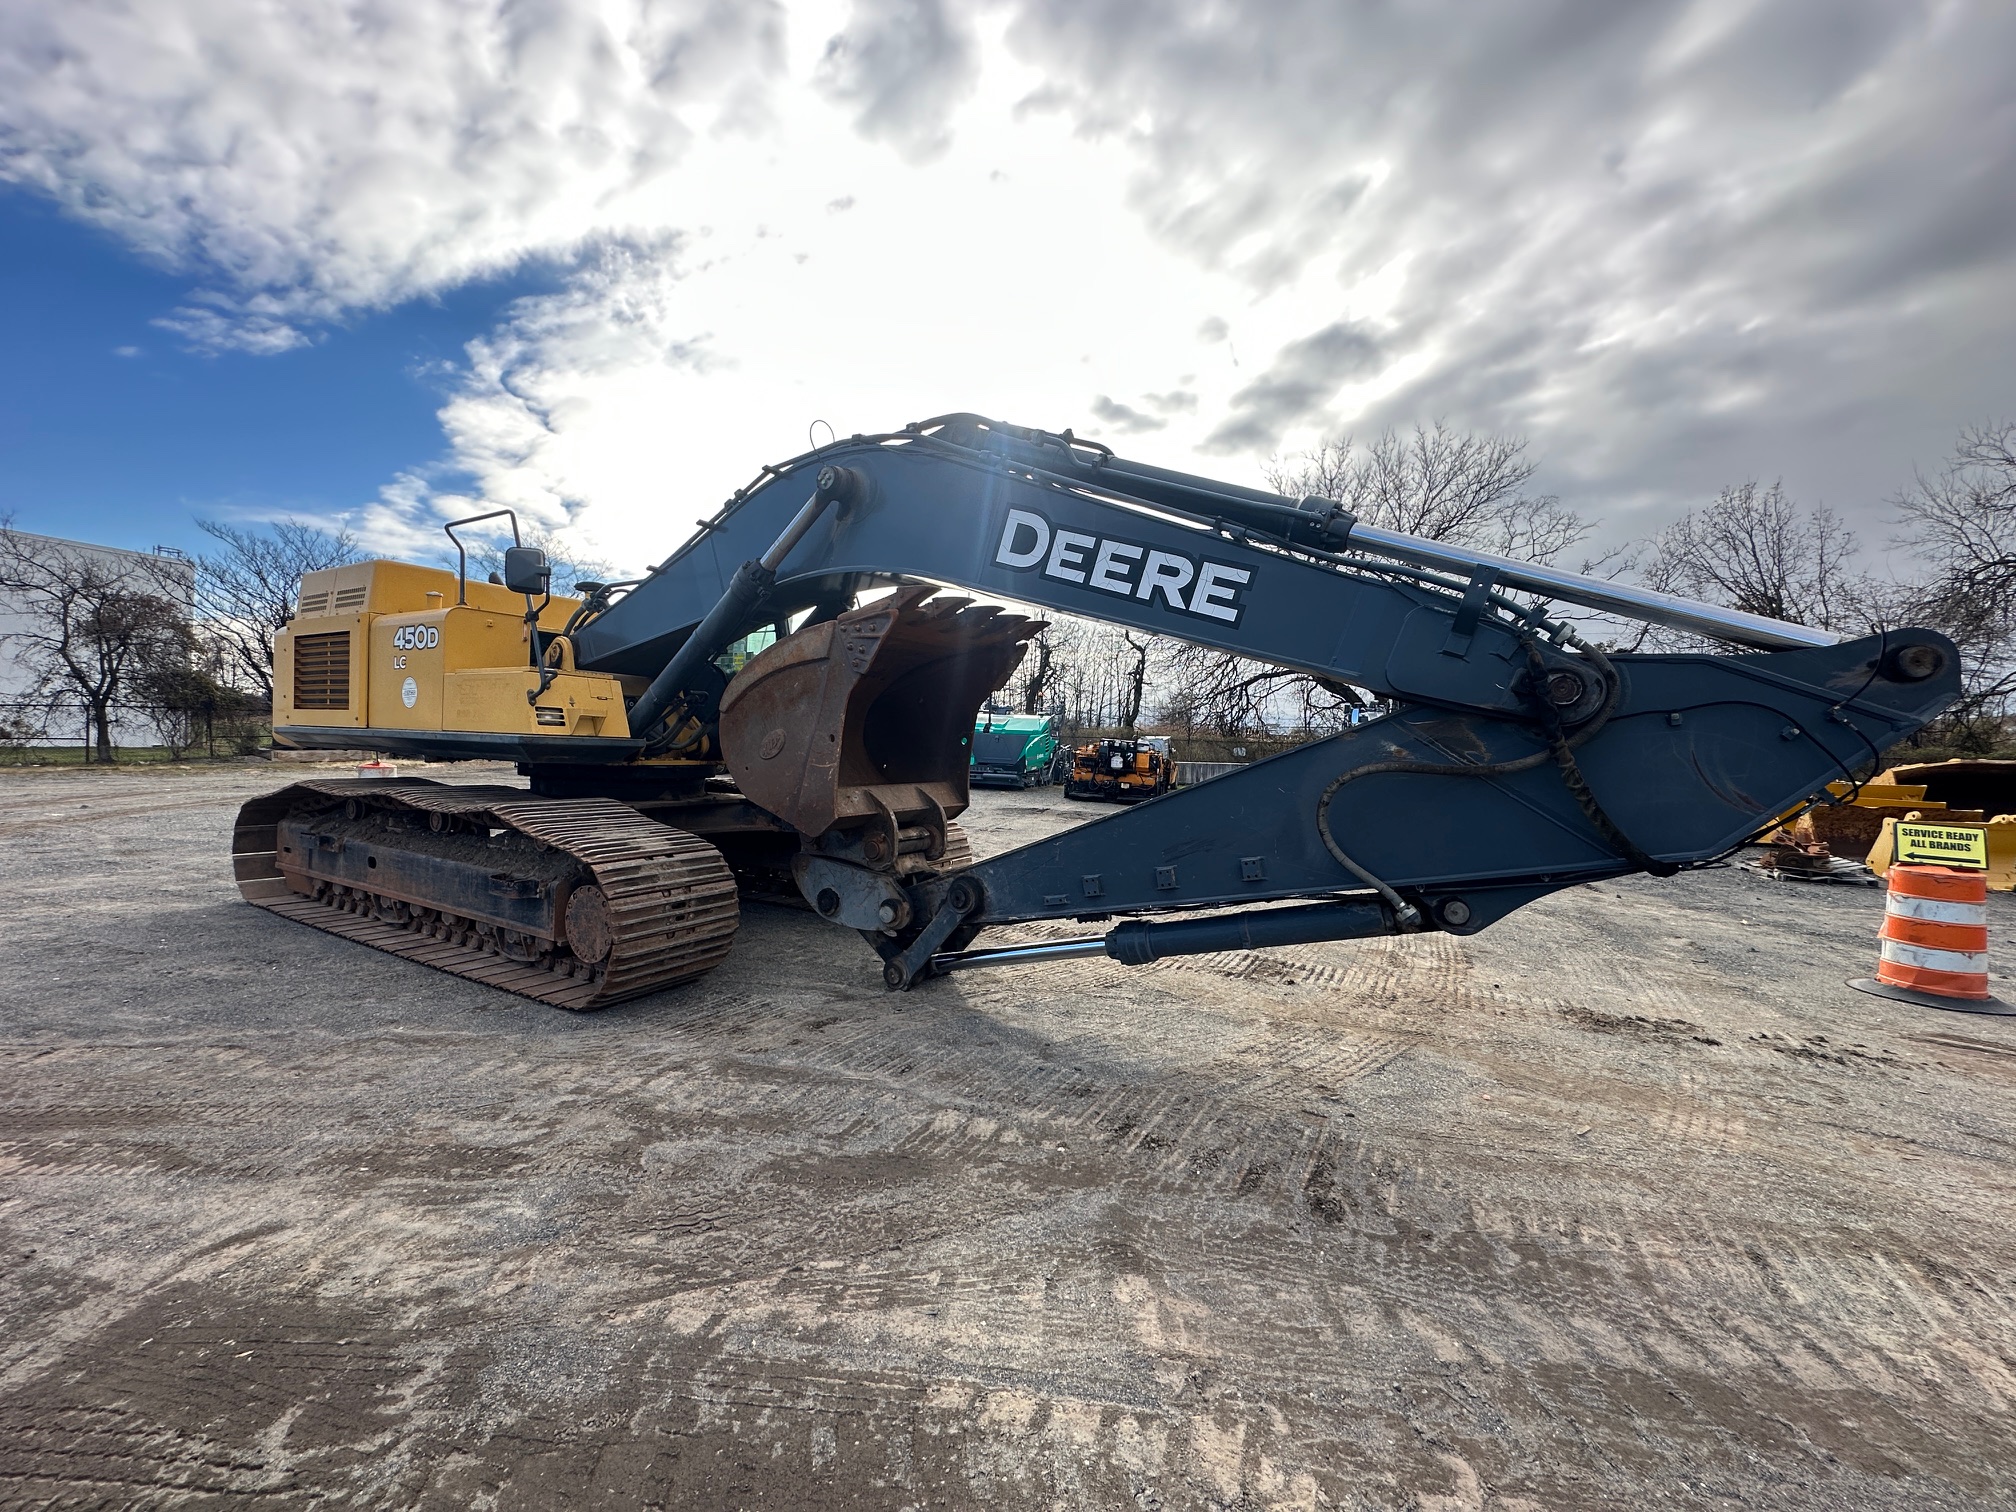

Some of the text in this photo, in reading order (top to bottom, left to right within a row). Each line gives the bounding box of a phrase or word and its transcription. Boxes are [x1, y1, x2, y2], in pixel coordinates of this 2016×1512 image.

[996, 509, 1251, 622] DEERE
[393, 624, 439, 650] 450D
[393, 655, 407, 670] LC
[1902, 828, 1979, 841] SERVICE READY
[1910, 839, 1971, 851] ALL BRANDS
